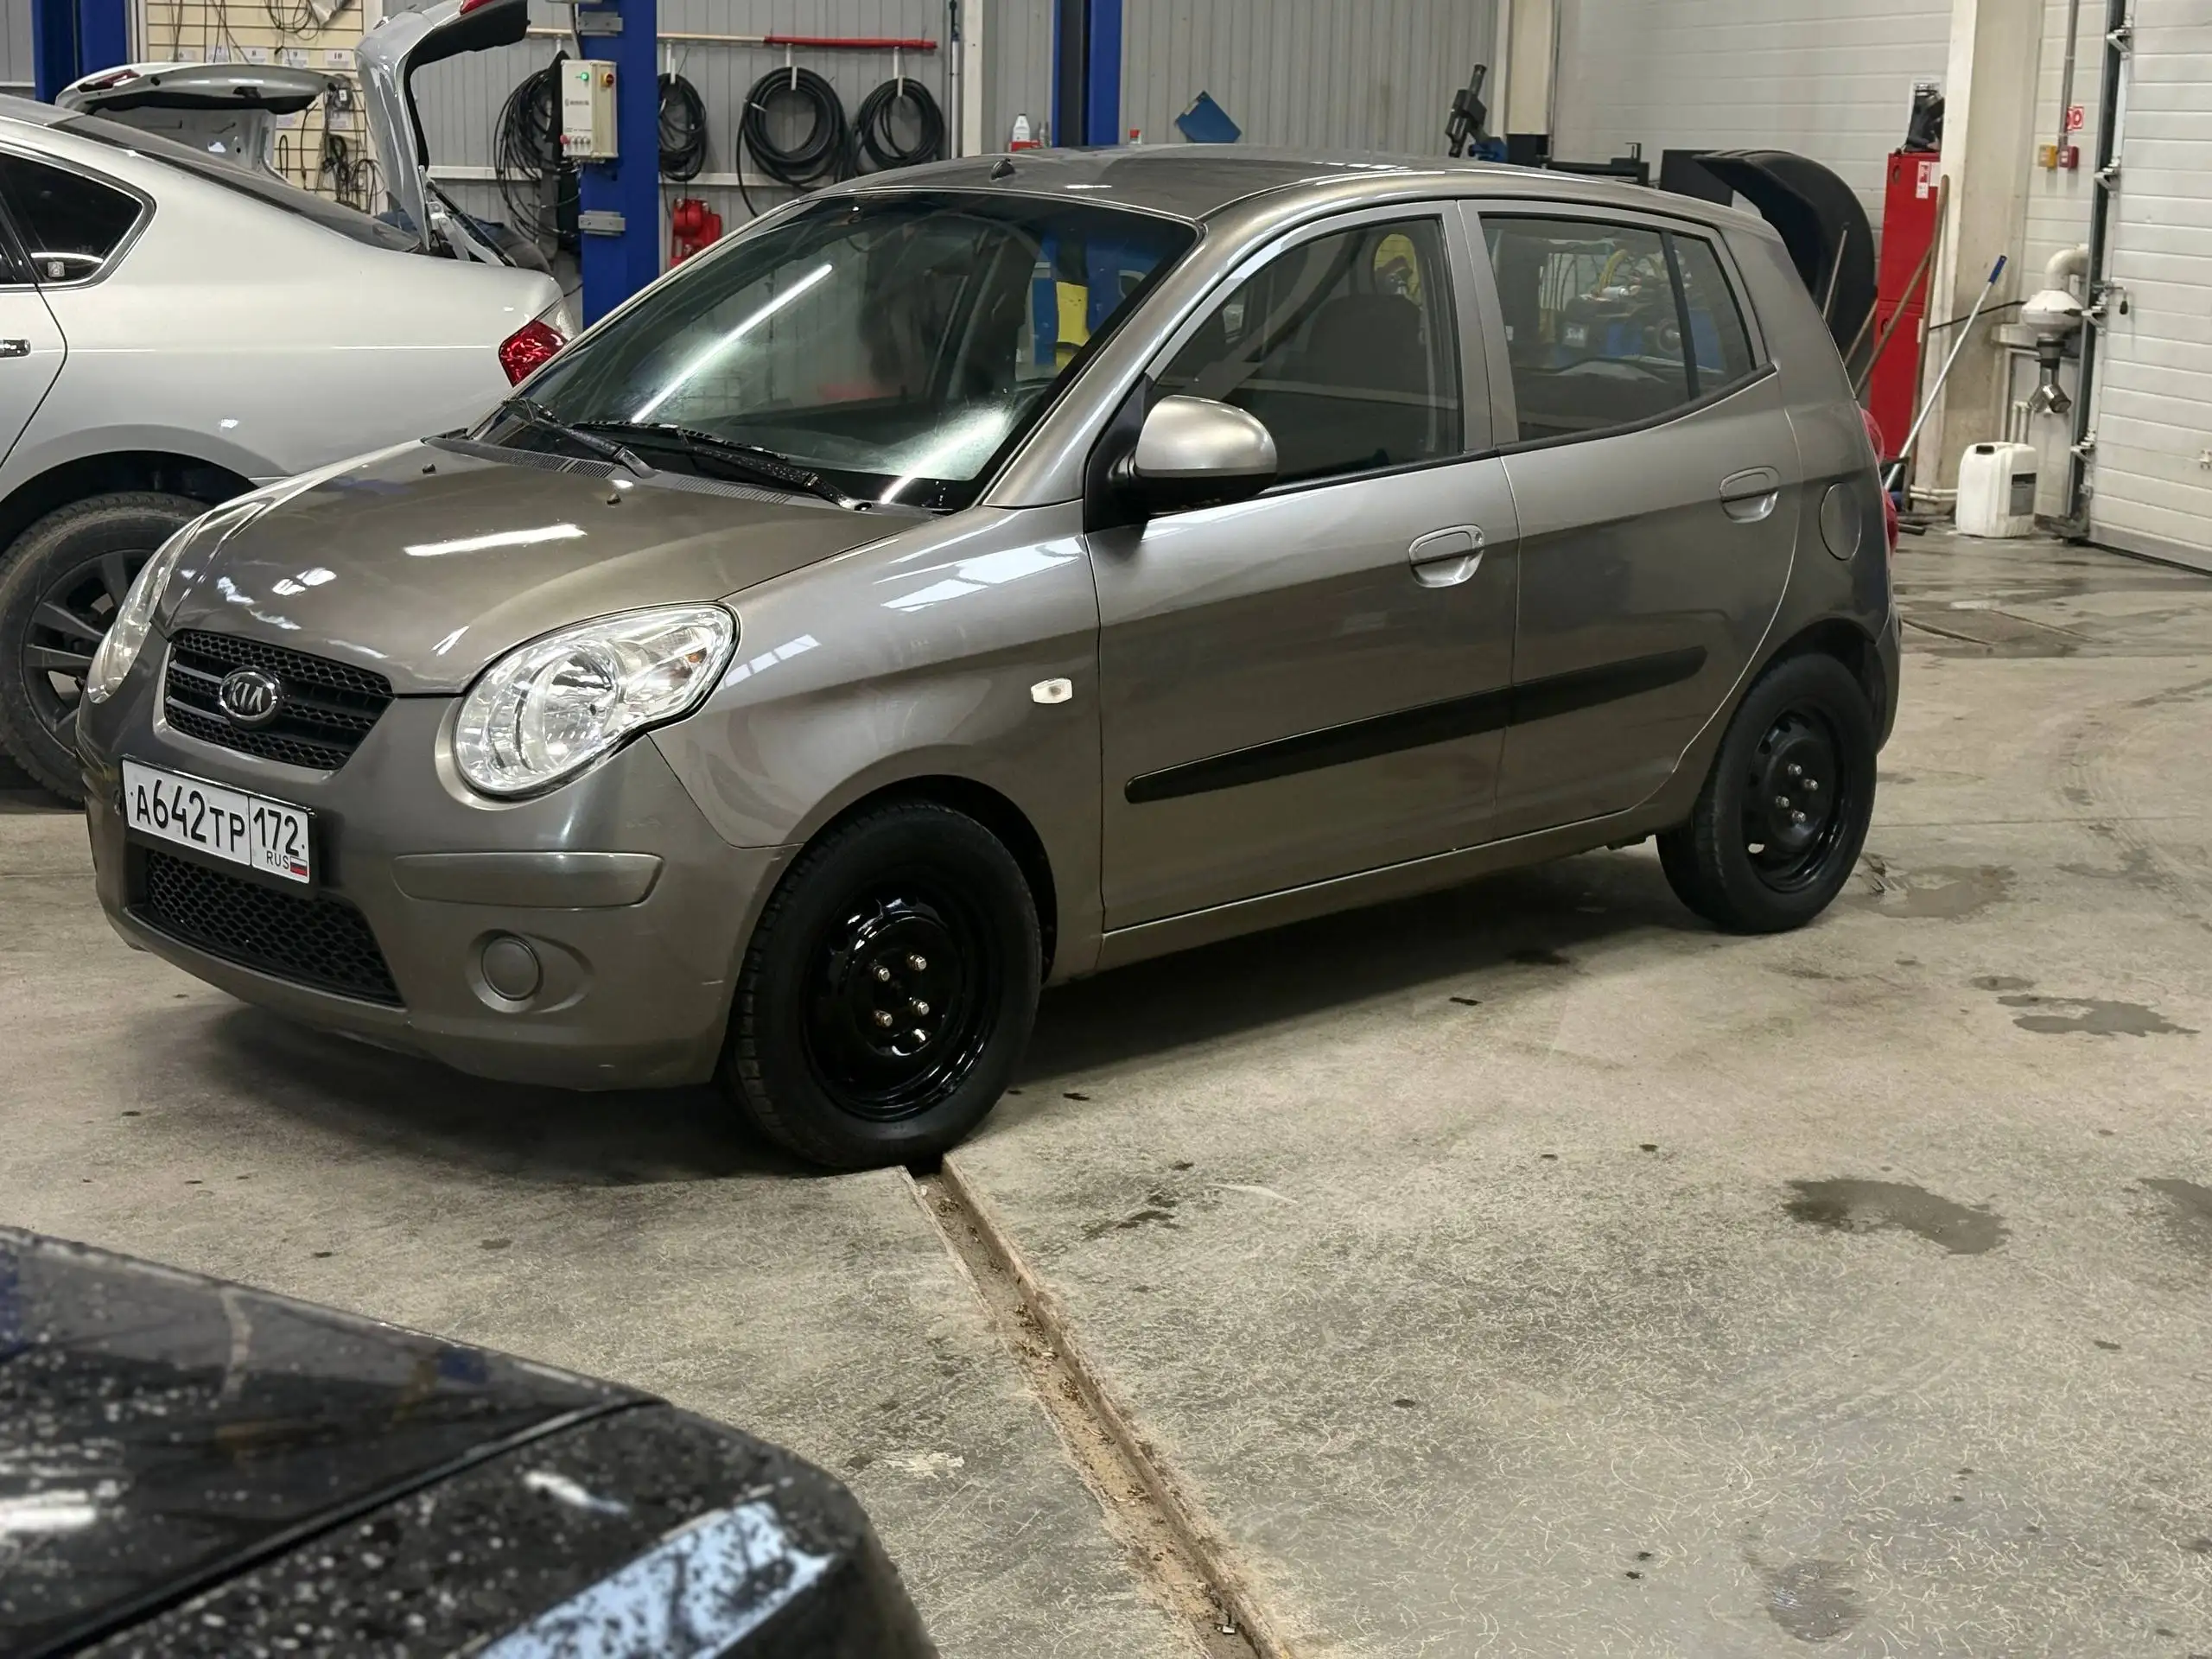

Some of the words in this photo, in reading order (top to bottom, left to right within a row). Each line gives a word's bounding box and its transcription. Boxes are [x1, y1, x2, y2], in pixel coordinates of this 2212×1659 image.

[228, 677, 264, 712] KIA
[137, 779, 246, 853] A642TP
[253, 807, 300, 857] 172
[266, 850, 290, 870] RUS
